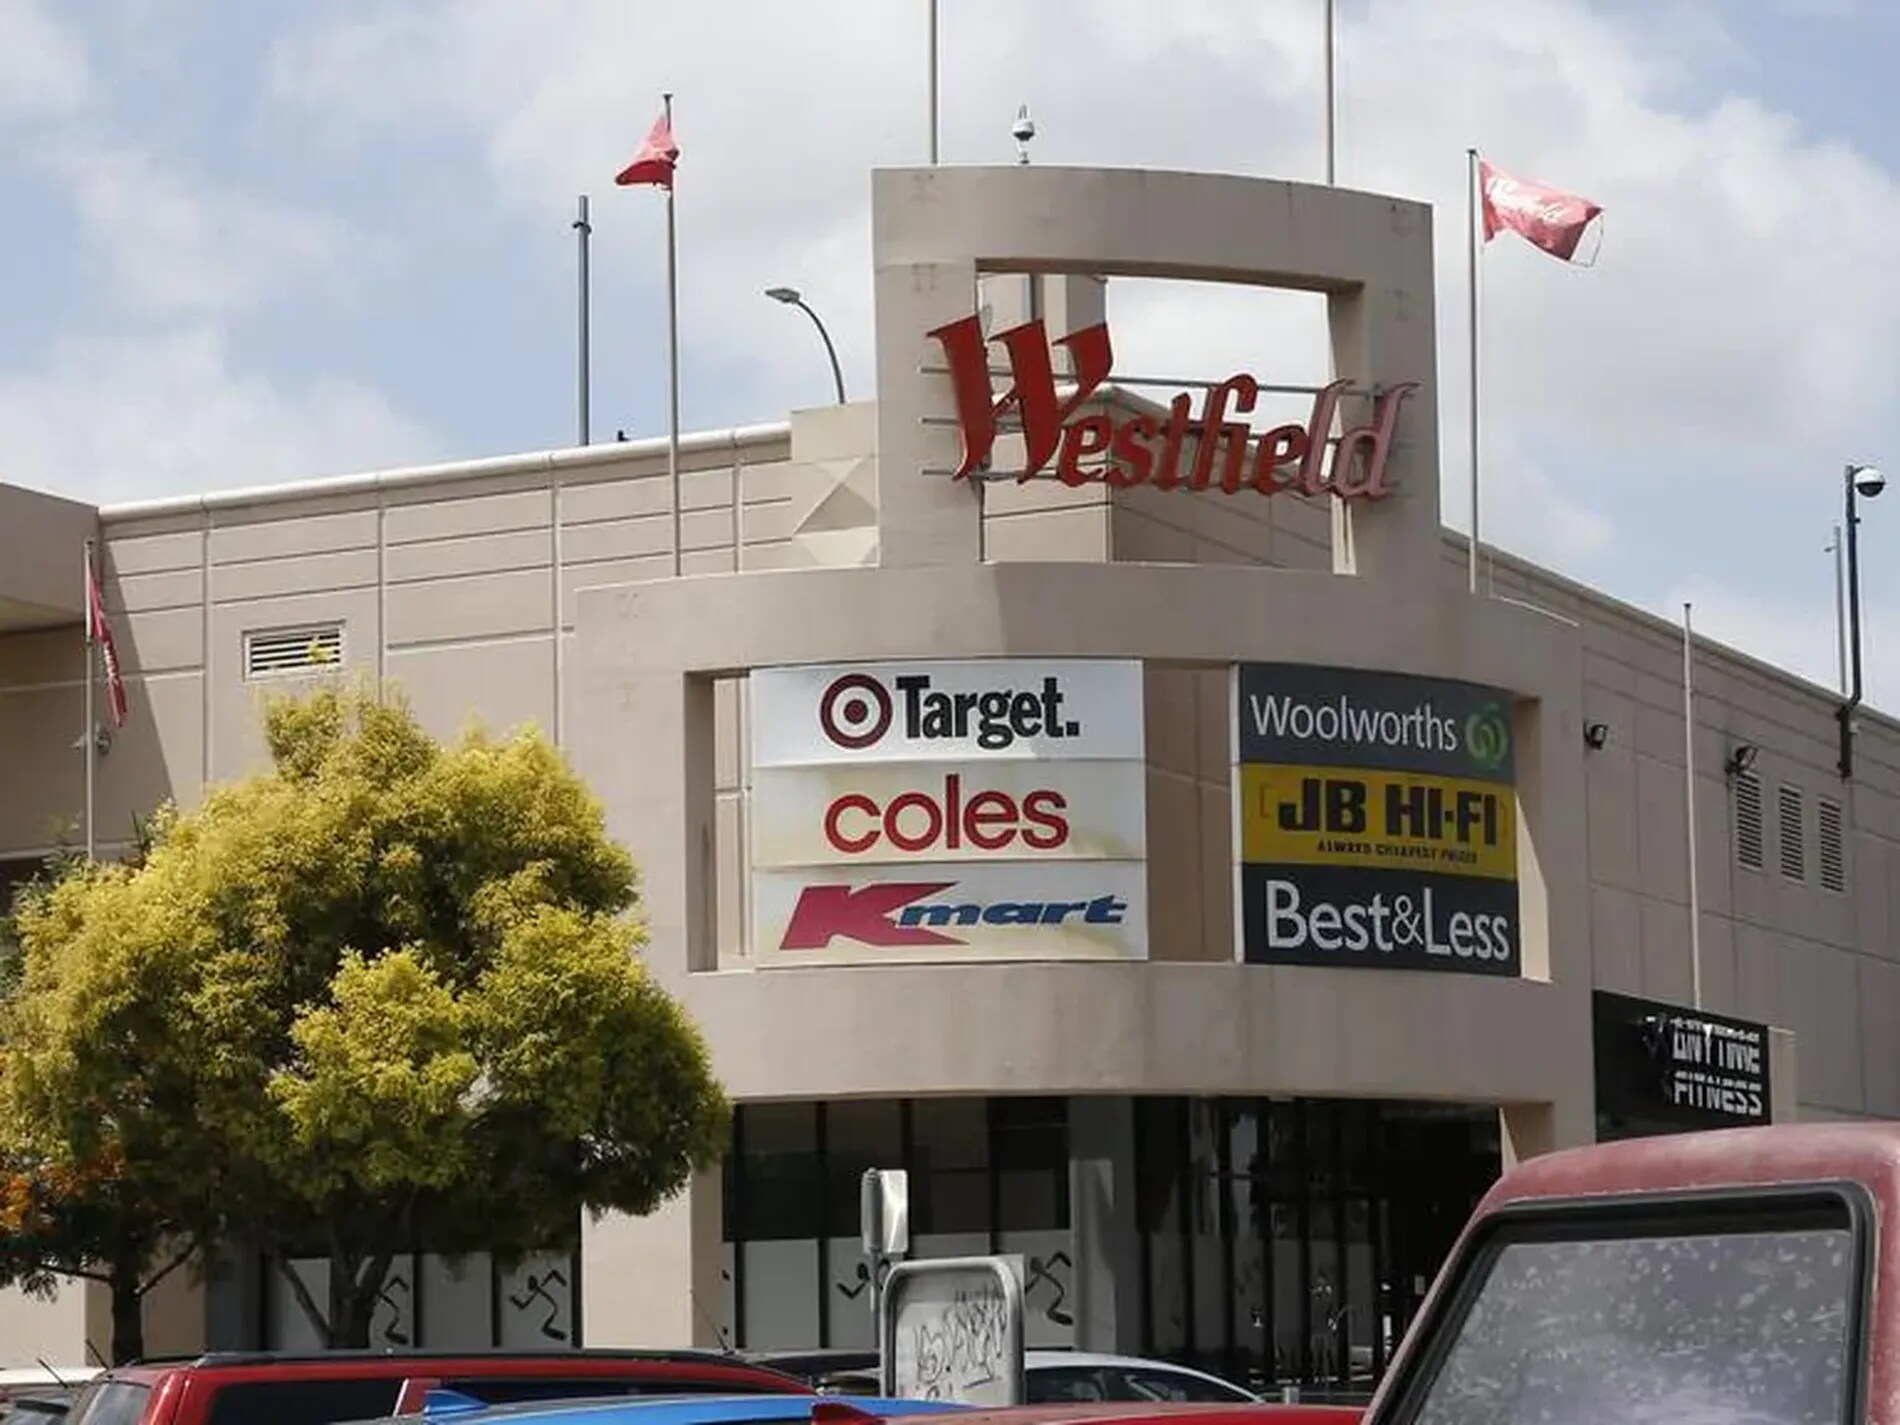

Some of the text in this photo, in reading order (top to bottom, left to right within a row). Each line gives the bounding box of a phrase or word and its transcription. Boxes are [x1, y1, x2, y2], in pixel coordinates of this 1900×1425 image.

[925, 314, 1420, 501] Westfield
[896, 675, 1079, 749] Target.
[1250, 694, 1457, 751] Woolworths
[825, 773, 1069, 853] coles
[1278, 778, 1497, 846] JB HI-FI
[779, 881, 1127, 950] Kmart
[1265, 879, 1509, 961] Best&Less
[1673, 1070, 1762, 1116] FITNESS
